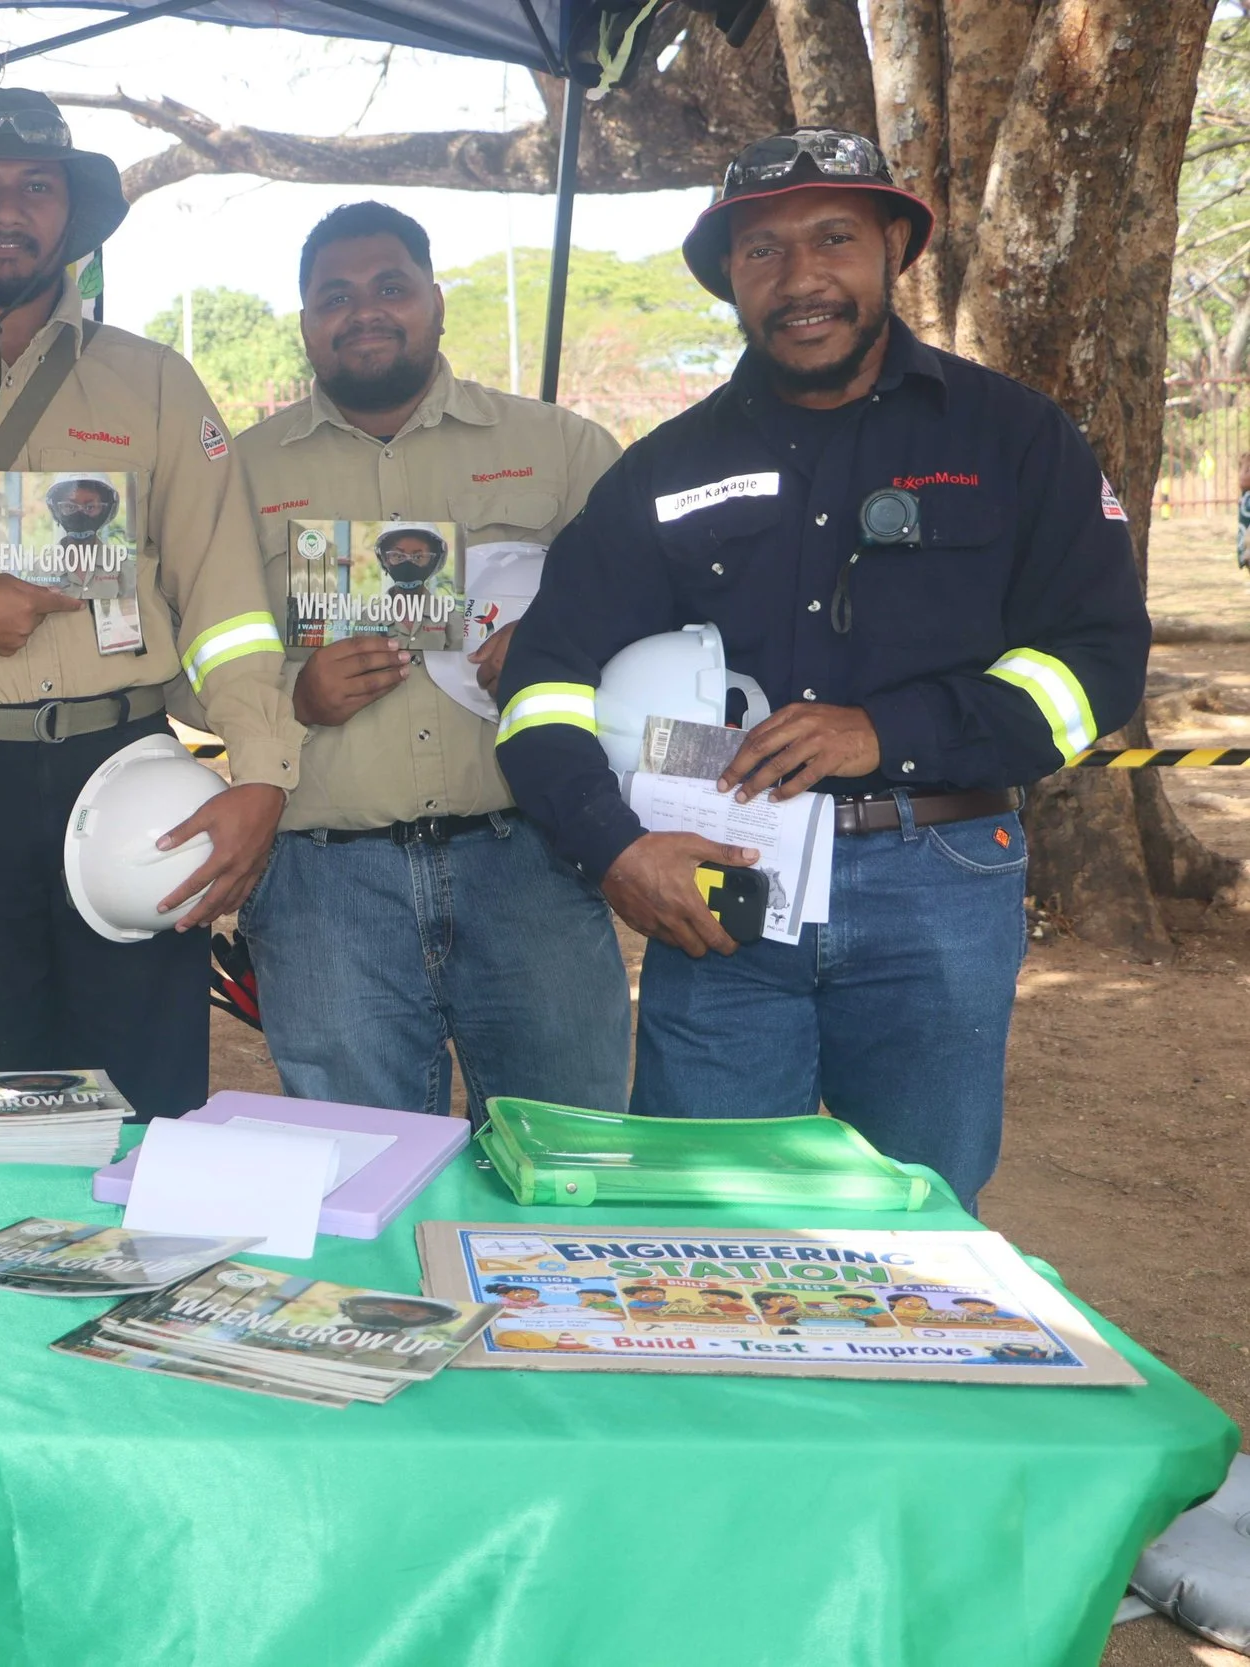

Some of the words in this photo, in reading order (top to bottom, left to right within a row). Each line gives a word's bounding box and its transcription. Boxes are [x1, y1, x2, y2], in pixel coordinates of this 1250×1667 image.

[67, 428, 130, 446] ExxonMobil
[472, 466, 533, 483] ExxonMobil
[892, 471, 979, 490] ExxonMobil
[674, 492, 700, 510] John
[705, 479, 757, 497] Kawagle
[260, 503, 281, 514] JIMMY
[39, 543, 98, 572] GROW
[102, 544, 129, 573] UP
[297, 591, 350, 620] WHEN
[367, 592, 425, 622] GROW
[429, 593, 456, 623] UP
[464, 599, 475, 617] PNG
[70, 1092, 106, 1105] UP
[57, 1254, 147, 1273] GROW
[608, 1260, 890, 1284] STATION
[522, 1276, 573, 1284] DESIGN
[667, 1280, 710, 1288] BUILD
[171, 1295, 271, 1330] WHEN
[287, 1321, 397, 1349] GROW
[393, 1337, 444, 1356] UP
[613, 1336, 696, 1349] Build
[731, 1340, 808, 1353] Test
[846, 1342, 973, 1358] Improve
